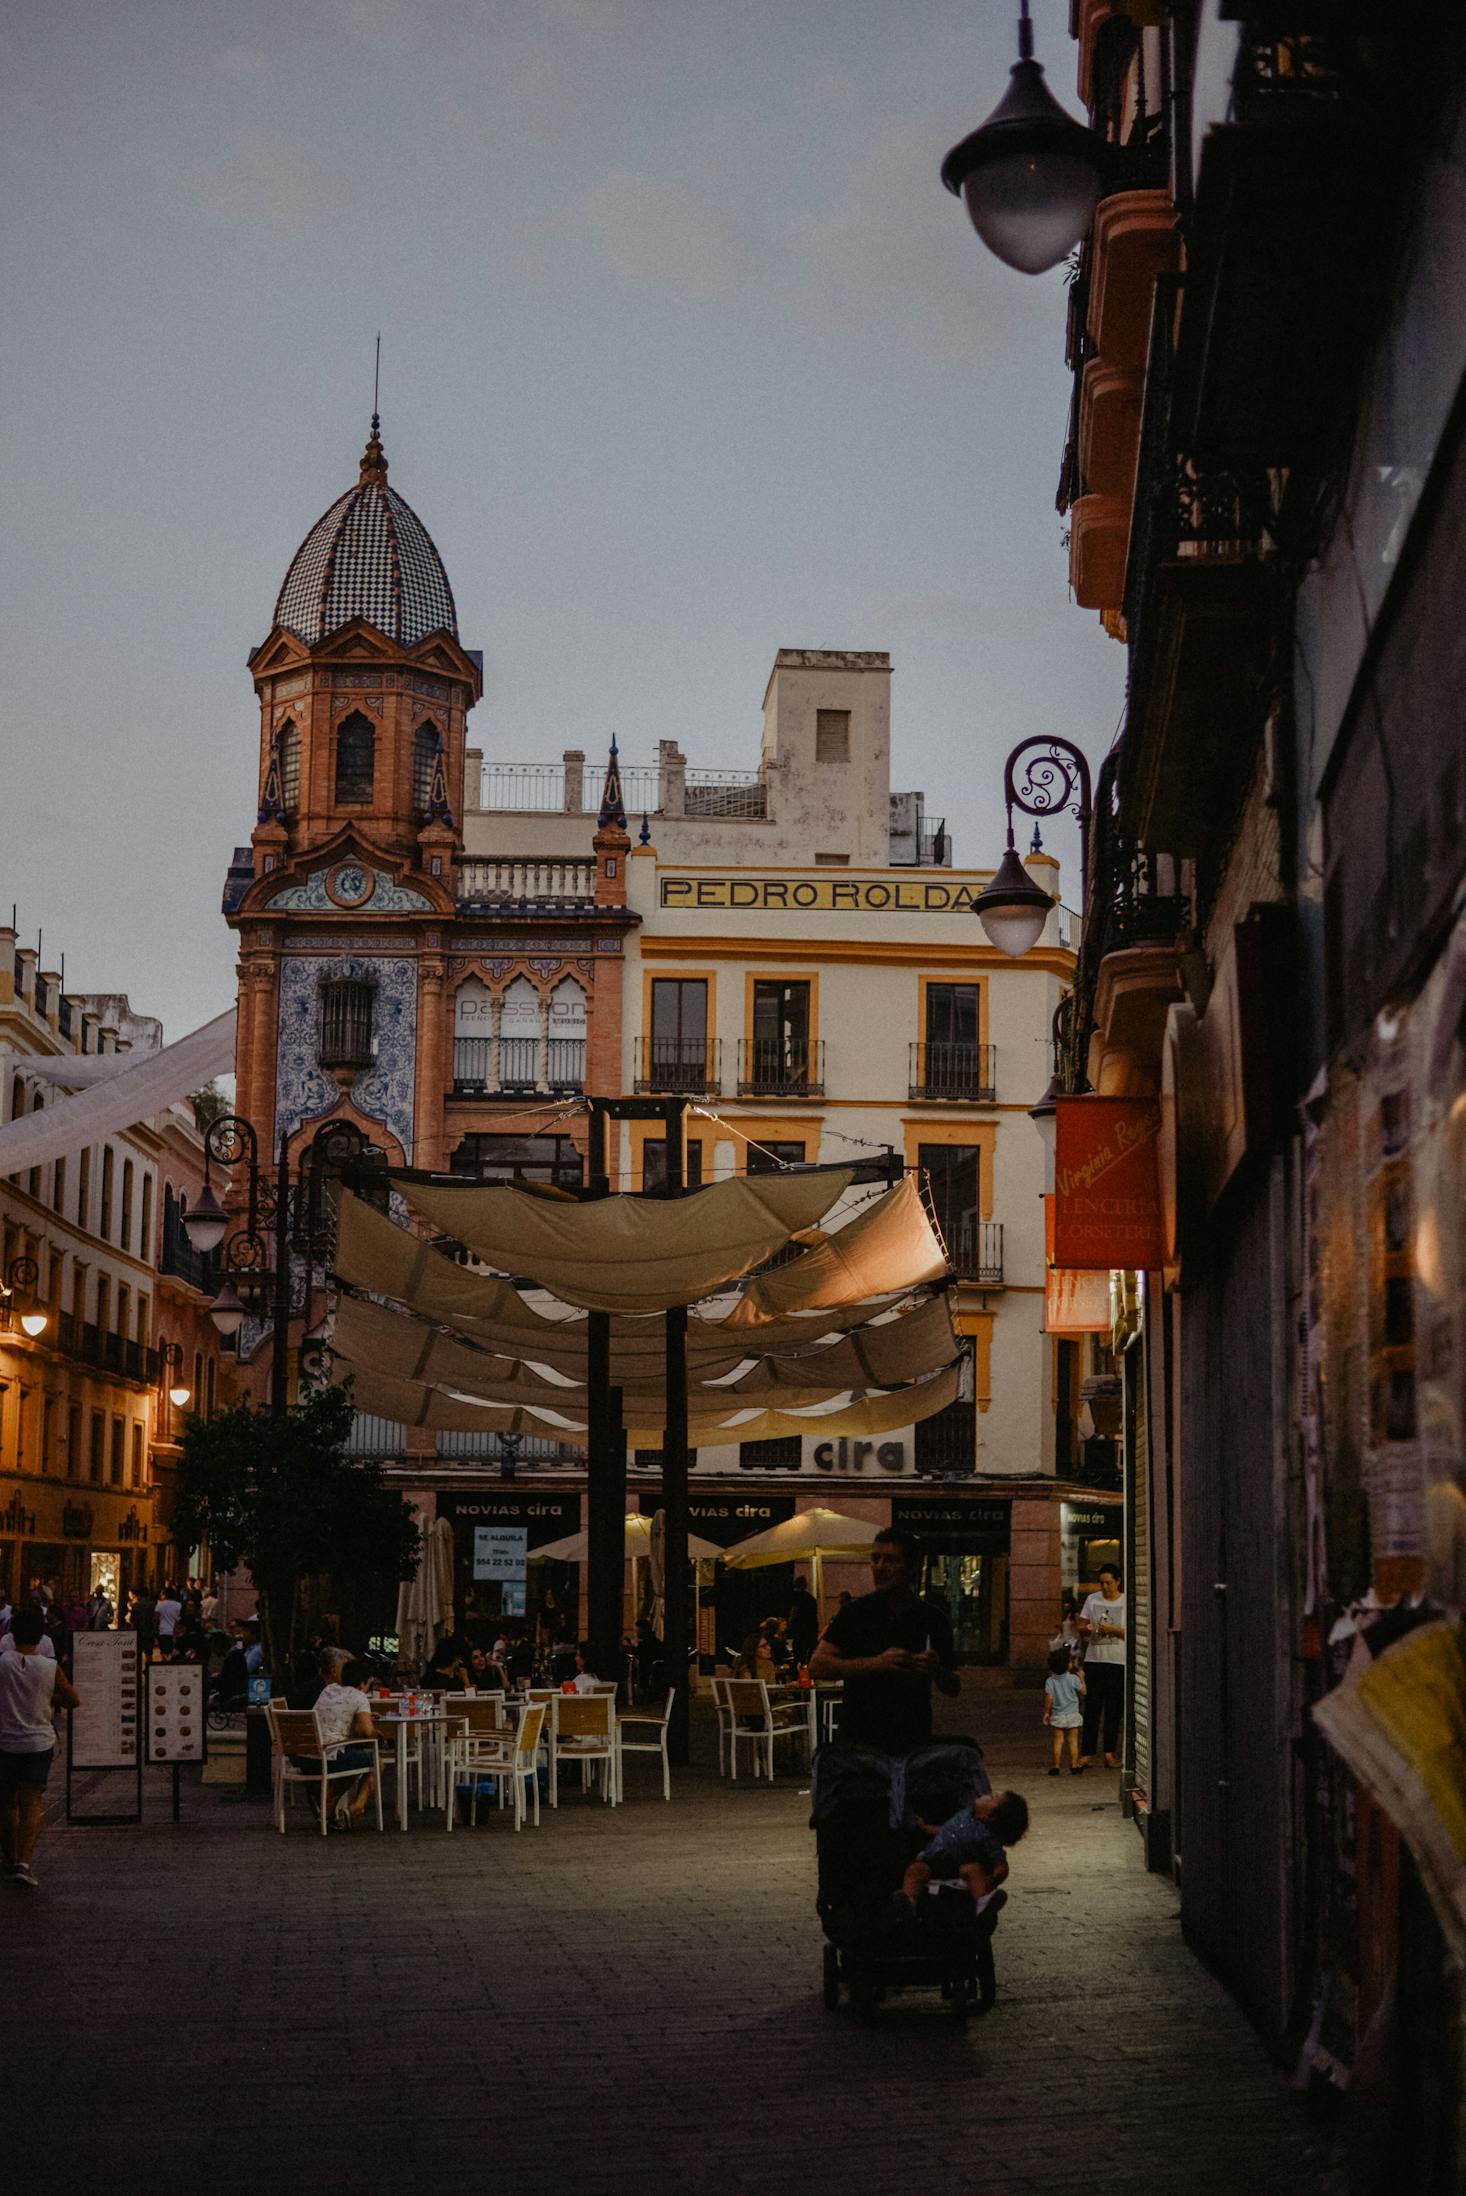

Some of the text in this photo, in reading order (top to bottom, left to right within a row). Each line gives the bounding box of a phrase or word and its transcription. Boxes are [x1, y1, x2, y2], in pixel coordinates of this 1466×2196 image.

[661, 880, 976, 911] PEDRO ROLDA
[460, 999, 586, 1021] passon
[1056, 1145, 1115, 1197] Virginia
[813, 1437, 904, 1472] cira
[455, 1502, 563, 1516] NOVIAS cira
[688, 1504, 772, 1518] VIAS cira
[897, 1508, 1005, 1521] NOVIAS cira
[491, 1534, 523, 1542] ALQUILA
[492, 1558, 503, 1567] 22
